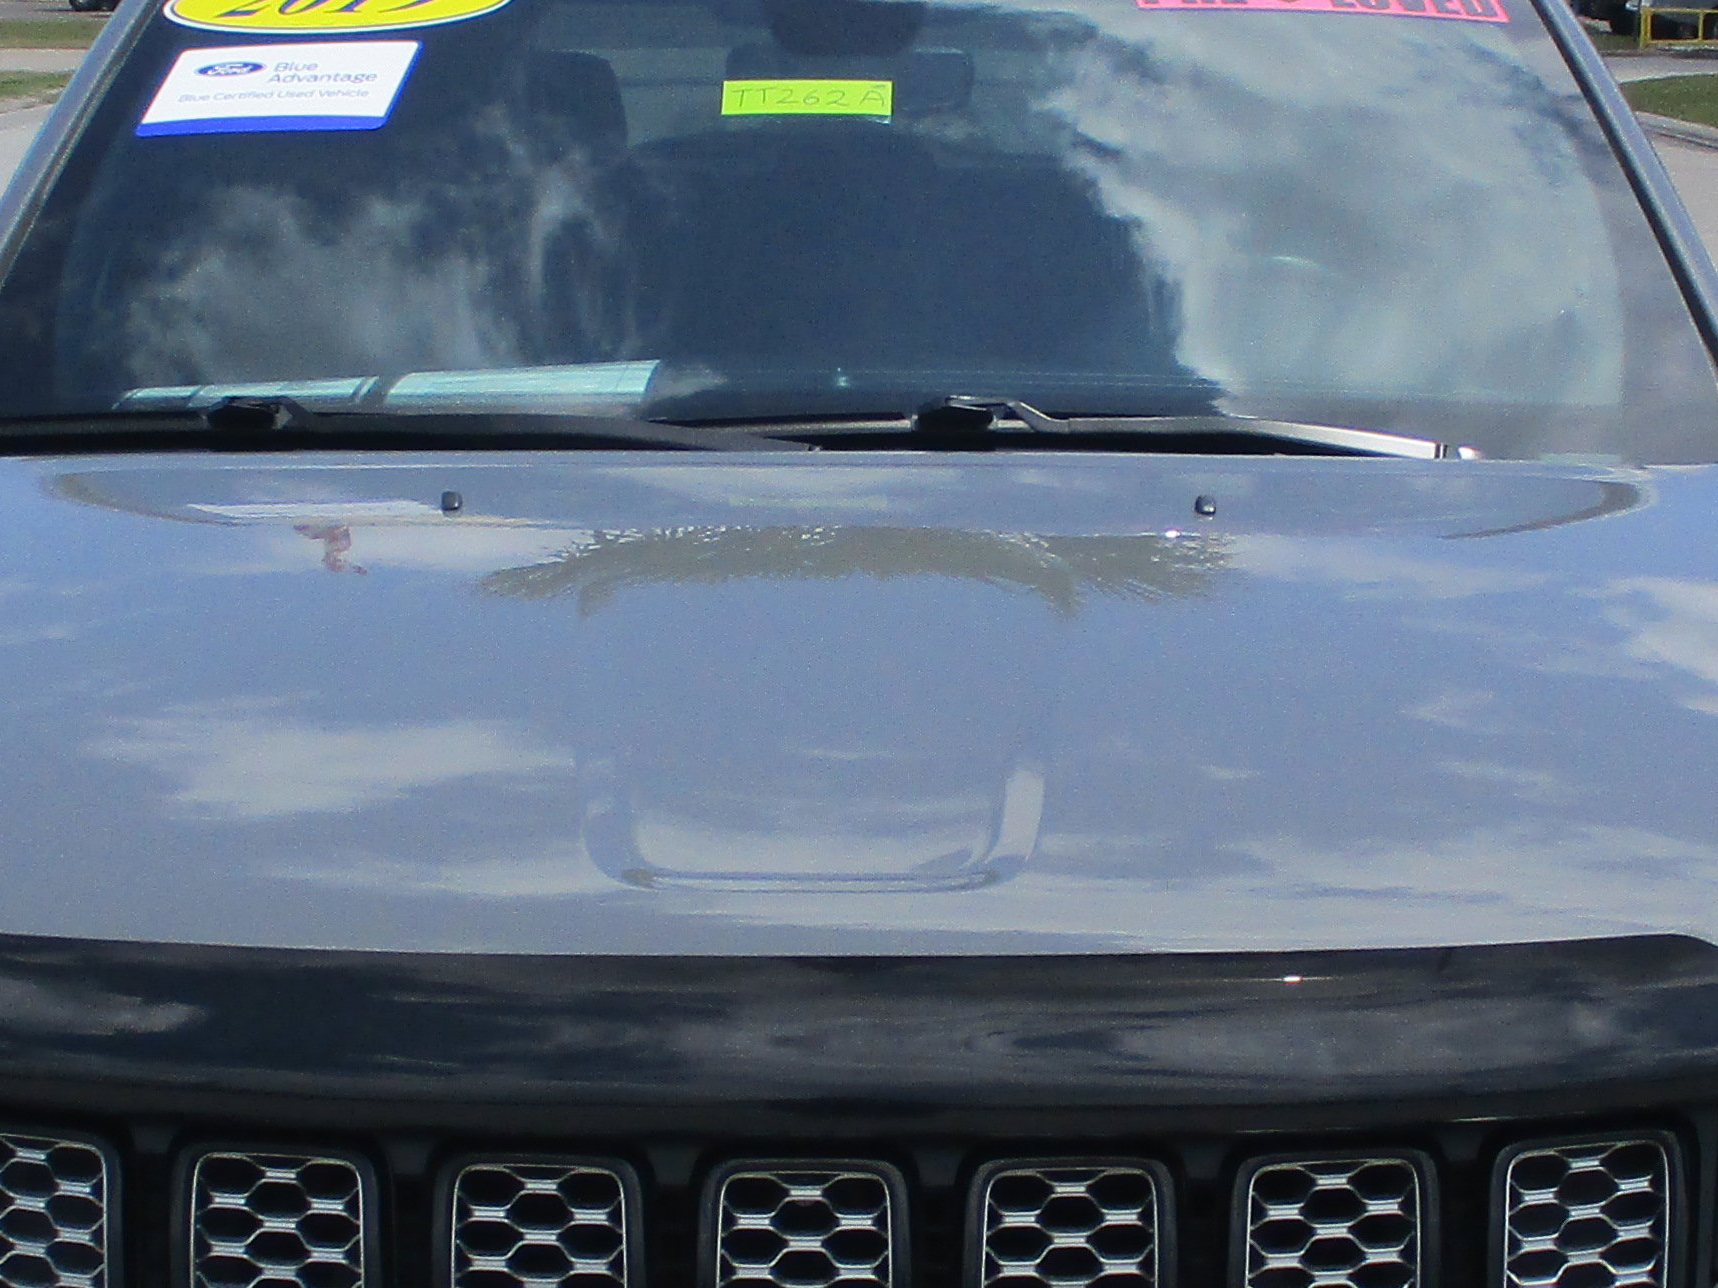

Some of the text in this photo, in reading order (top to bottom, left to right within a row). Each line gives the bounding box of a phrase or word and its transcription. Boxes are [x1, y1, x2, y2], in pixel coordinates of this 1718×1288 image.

[273, 62, 318, 72] Blue
[267, 72, 378, 85] Advantage
[178, 87, 369, 102] Blue Certified Used Vehicle
